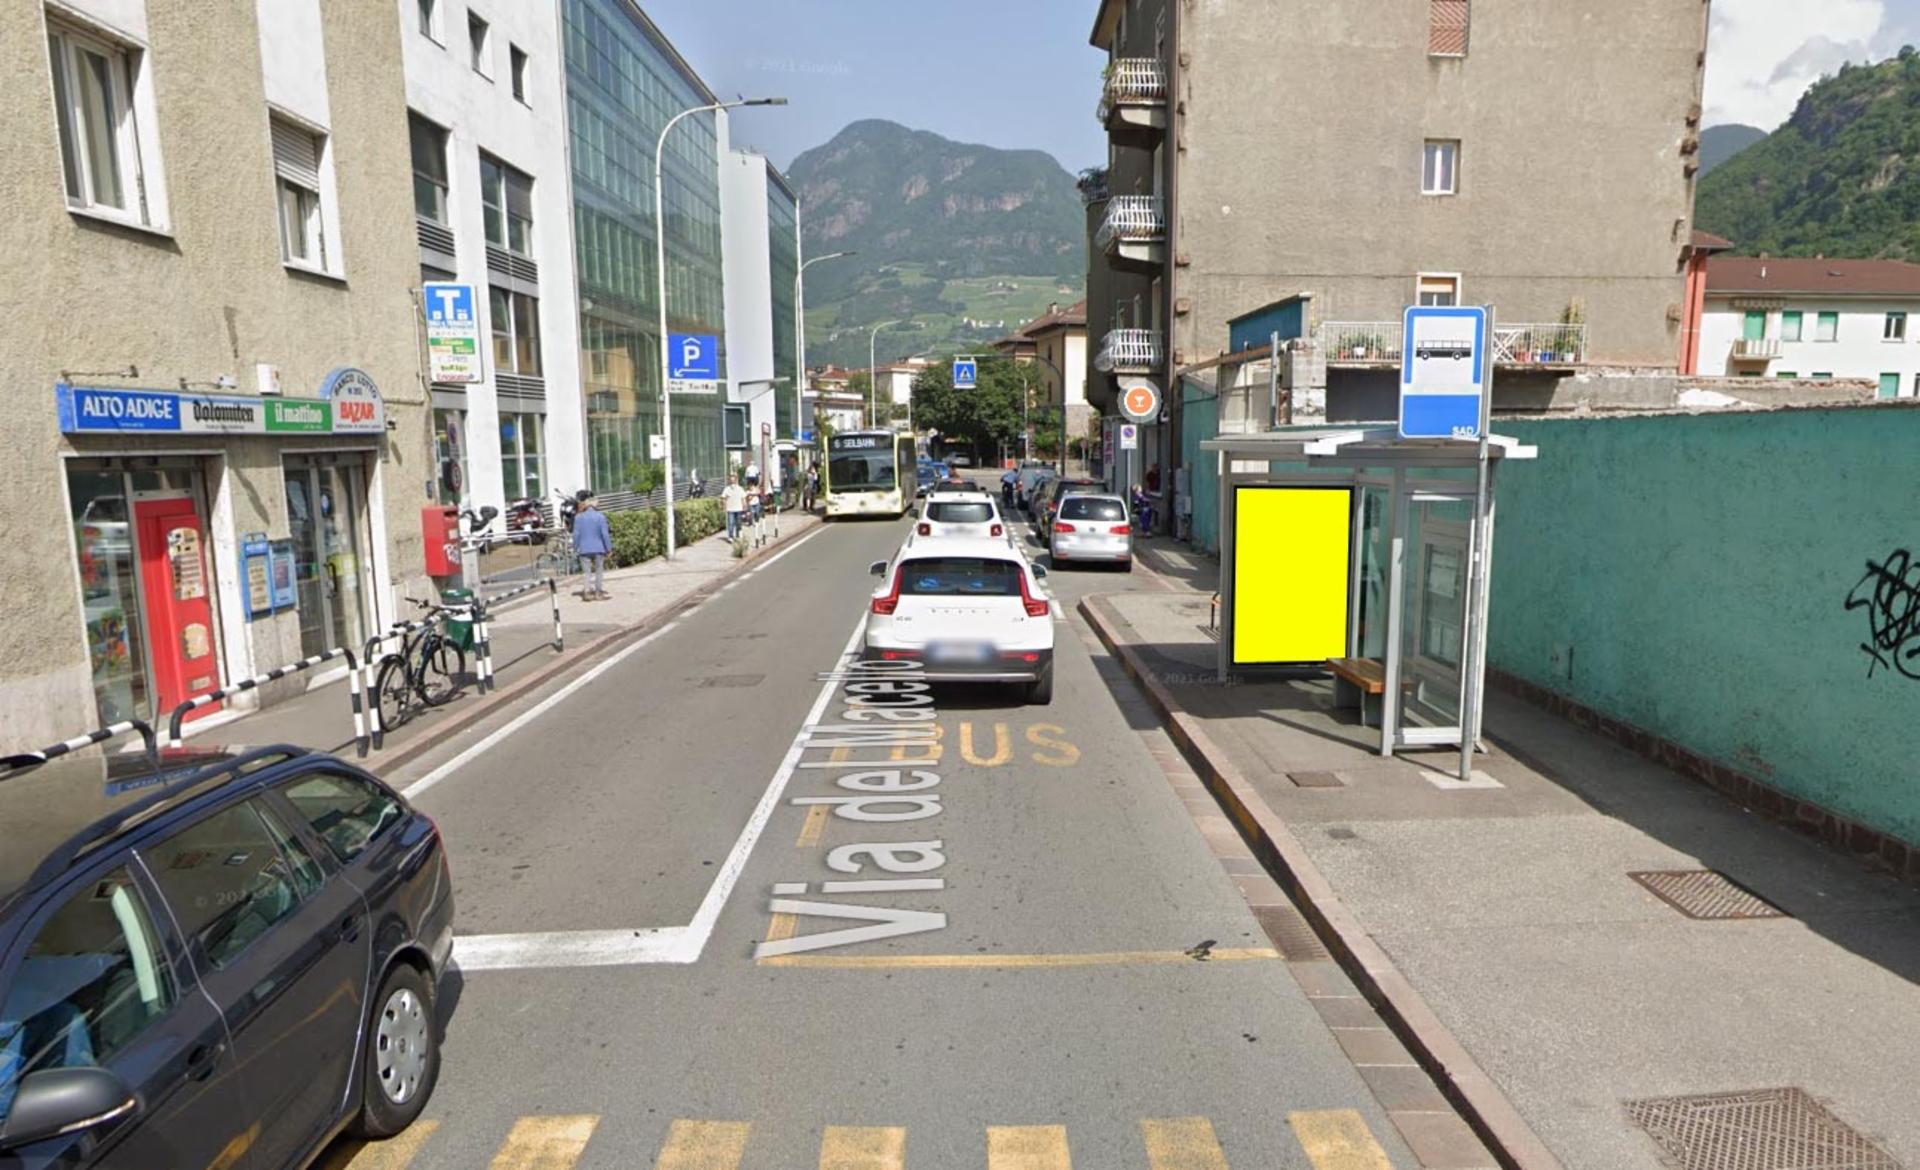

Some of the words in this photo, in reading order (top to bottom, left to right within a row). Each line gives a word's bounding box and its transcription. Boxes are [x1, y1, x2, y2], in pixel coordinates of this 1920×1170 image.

[683, 345, 701, 367] P
[83, 395, 123, 418] ALTO
[125, 397, 173, 419] ADIGE
[193, 399, 254, 423] Dolomiten
[274, 402, 283, 422] il
[284, 404, 323, 424] mattino
[339, 401, 375, 423] BAZAR
